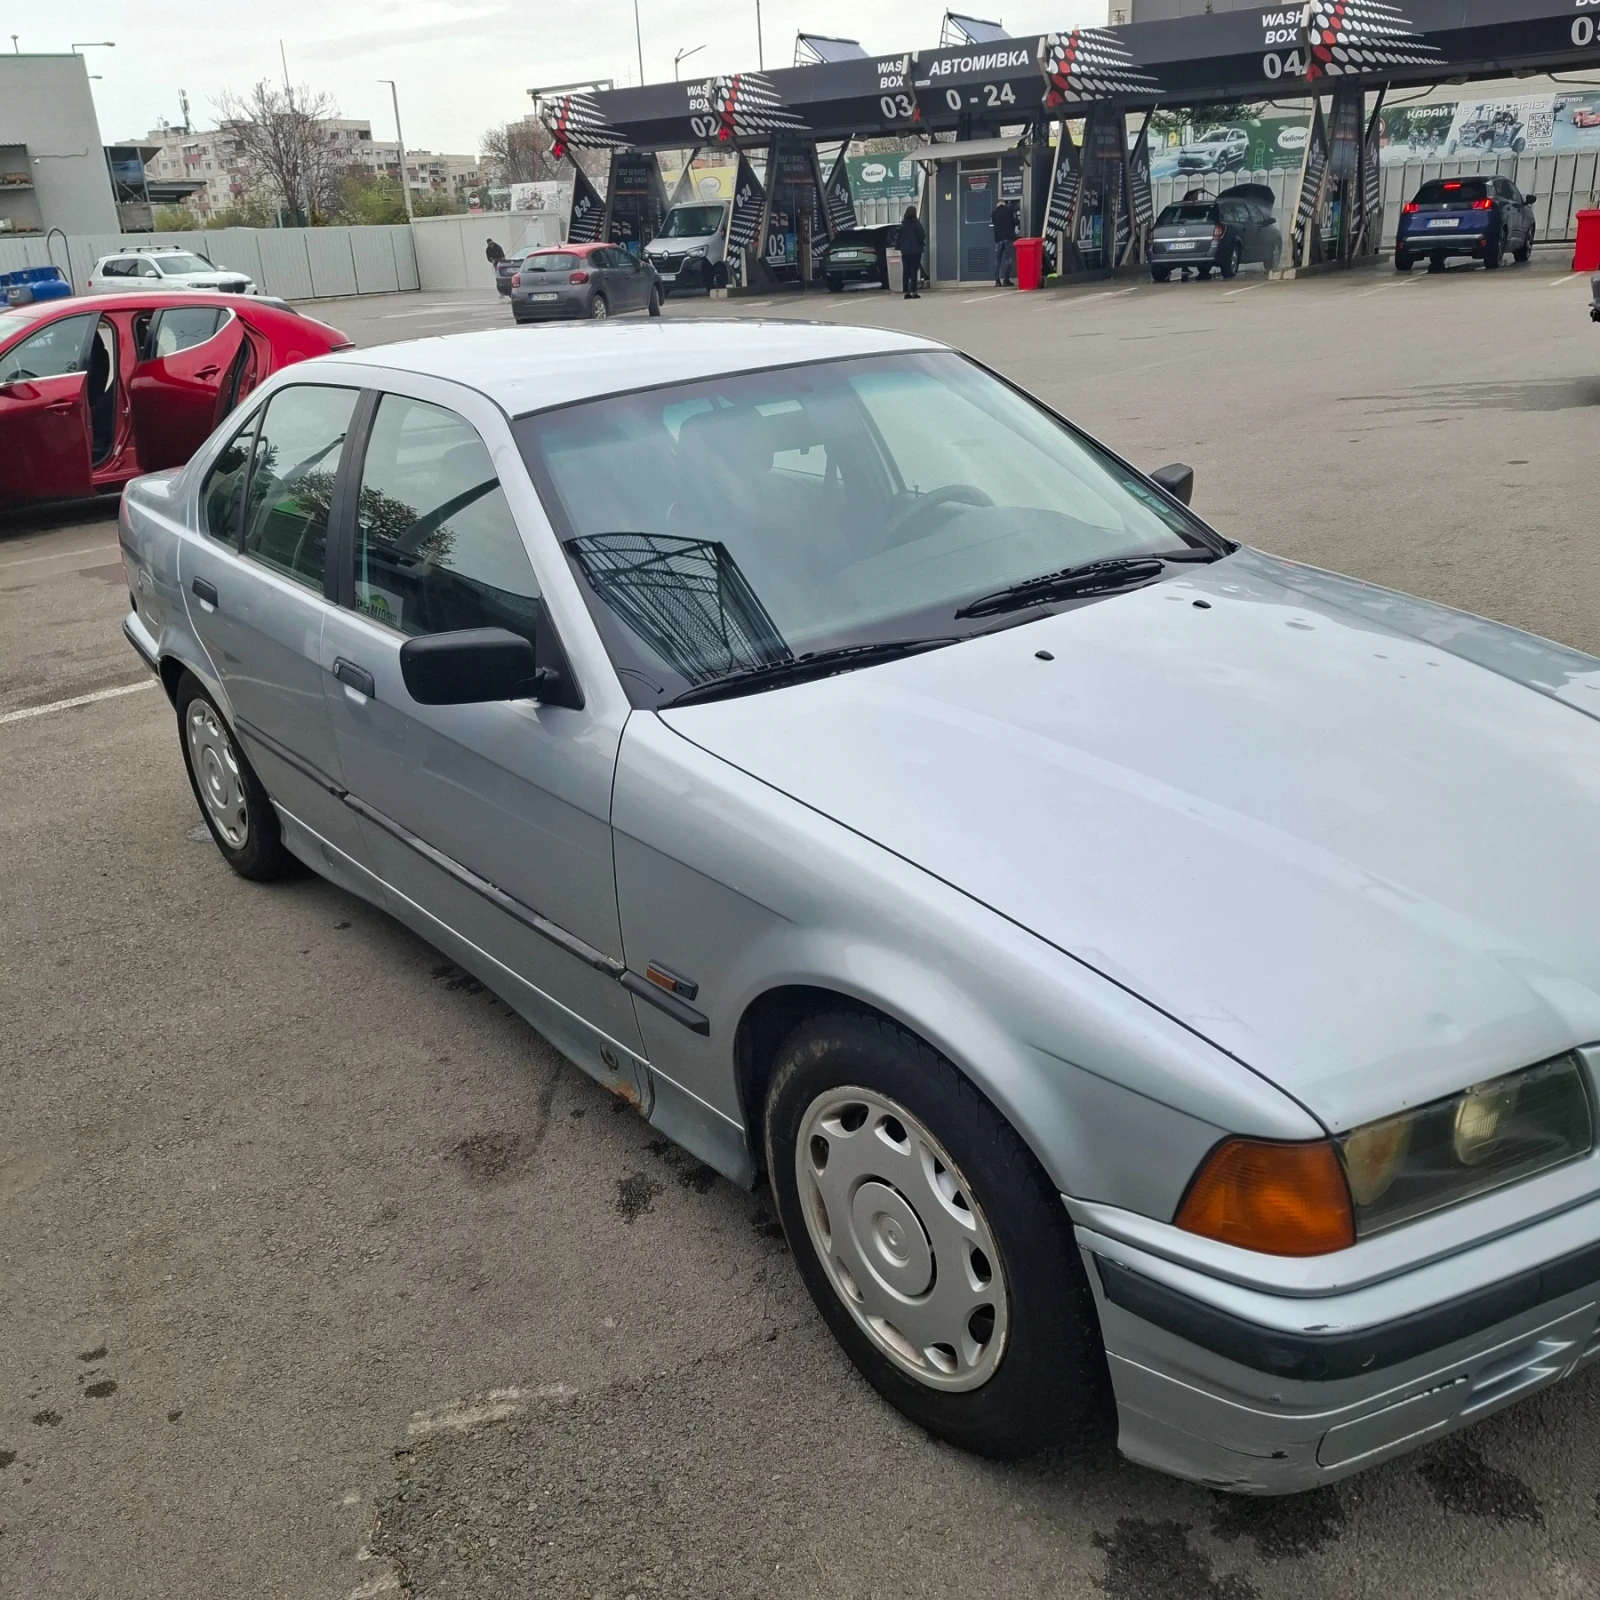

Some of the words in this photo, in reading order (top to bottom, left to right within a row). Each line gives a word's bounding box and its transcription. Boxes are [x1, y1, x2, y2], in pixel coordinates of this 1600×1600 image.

[1265, 28, 1298, 44] BOX
[1571, 16, 1600, 46] 0
[929, 50, 1029, 76] АВТОМИВКА
[1263, 50, 1304, 79] 04
[880, 76, 904, 88] BOX
[689, 98, 709, 110] BOX
[880, 94, 913, 119] 03
[984, 83, 1016, 107] 24
[1407, 105, 1447, 119] КАРАЙ
[691, 116, 719, 138] 02
[769, 234, 785, 257] 03
